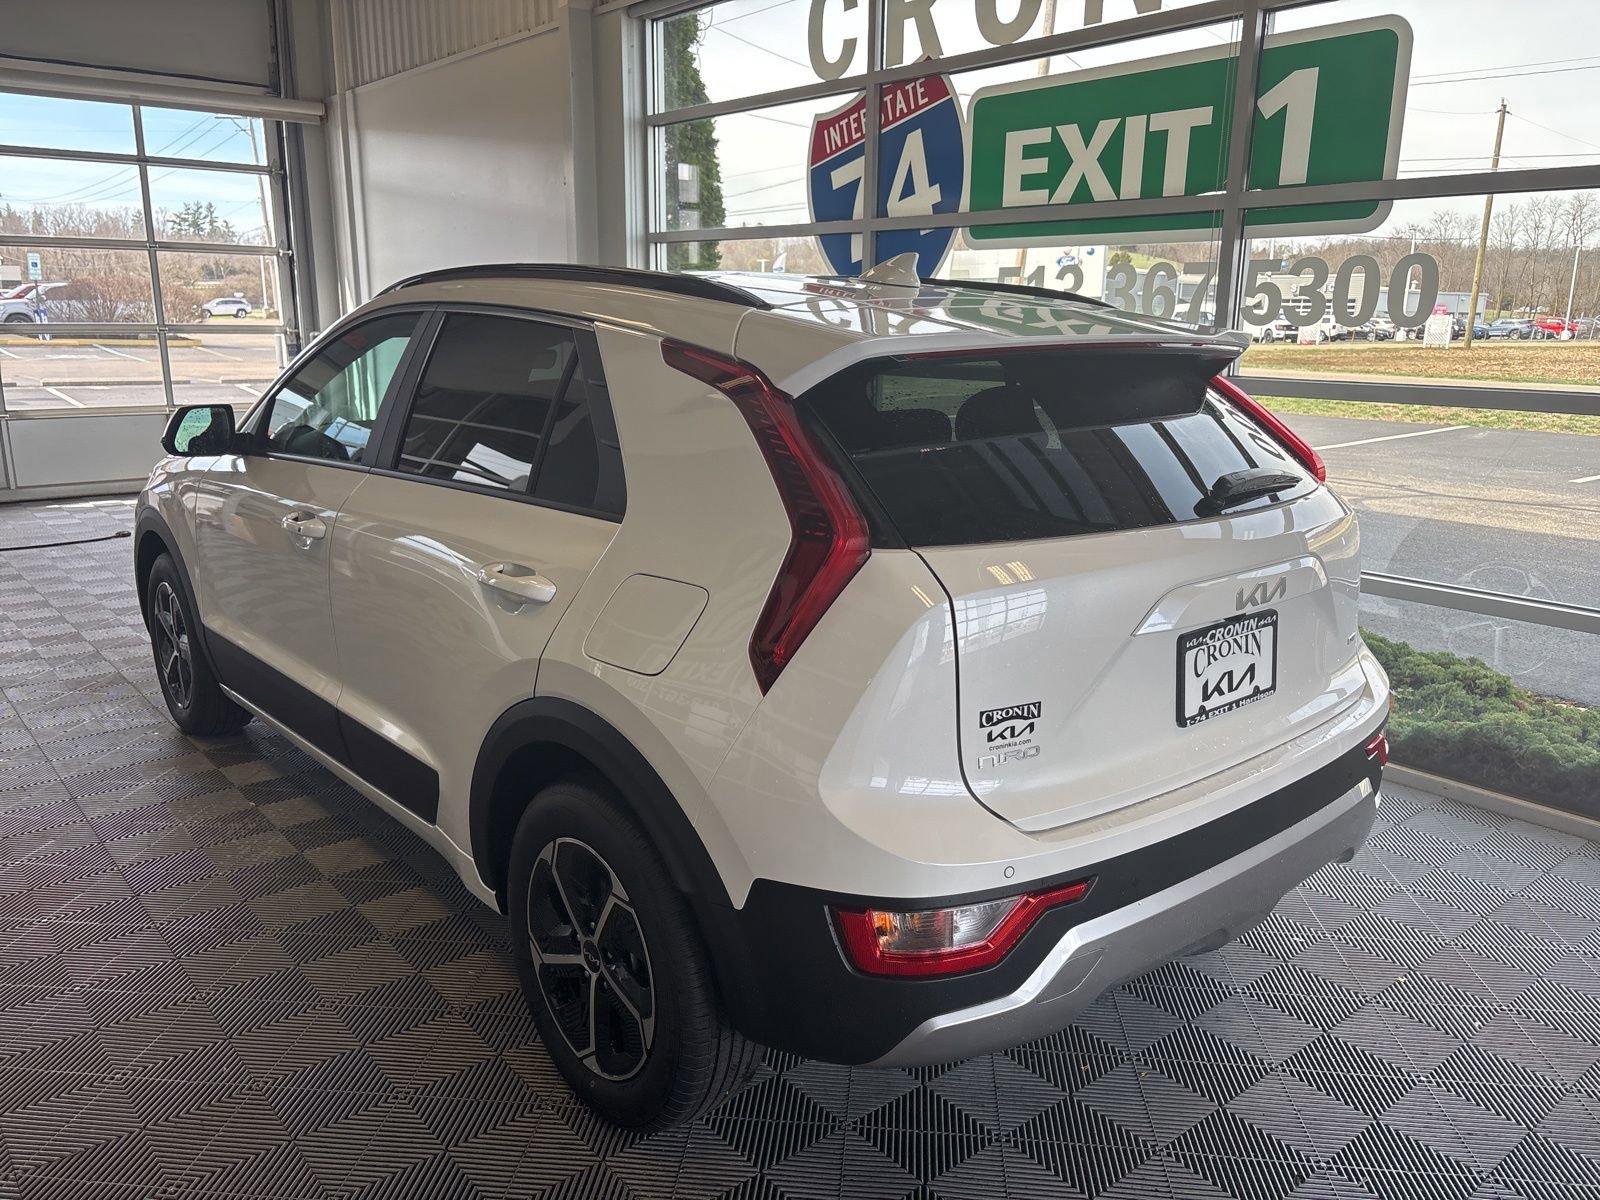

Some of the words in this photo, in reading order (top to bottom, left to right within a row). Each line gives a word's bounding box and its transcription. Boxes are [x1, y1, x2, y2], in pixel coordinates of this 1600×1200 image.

[808, 0, 1163, 81] CRO
[824, 77, 929, 154] INTERTATE
[1002, 106, 1214, 208] EXIT
[1256, 67, 1320, 186] 1
[831, 128, 942, 264] 74
[1240, 252, 1440, 329] 5300
[1236, 576, 1287, 611] KIA
[1206, 617, 1258, 645] CRONIN
[1193, 630, 1262, 678] CRONIN
[1202, 662, 1256, 703] KIA
[981, 703, 1039, 727] CRONIN
[1186, 713, 1207, 727] I-74
[1208, 705, 1230, 718] EXIT
[1239, 689, 1275, 706] Harrison
[987, 721, 1035, 743] KIA
[988, 738, 1032, 752] croninkia.com
[977, 745, 1041, 769] NIRO
